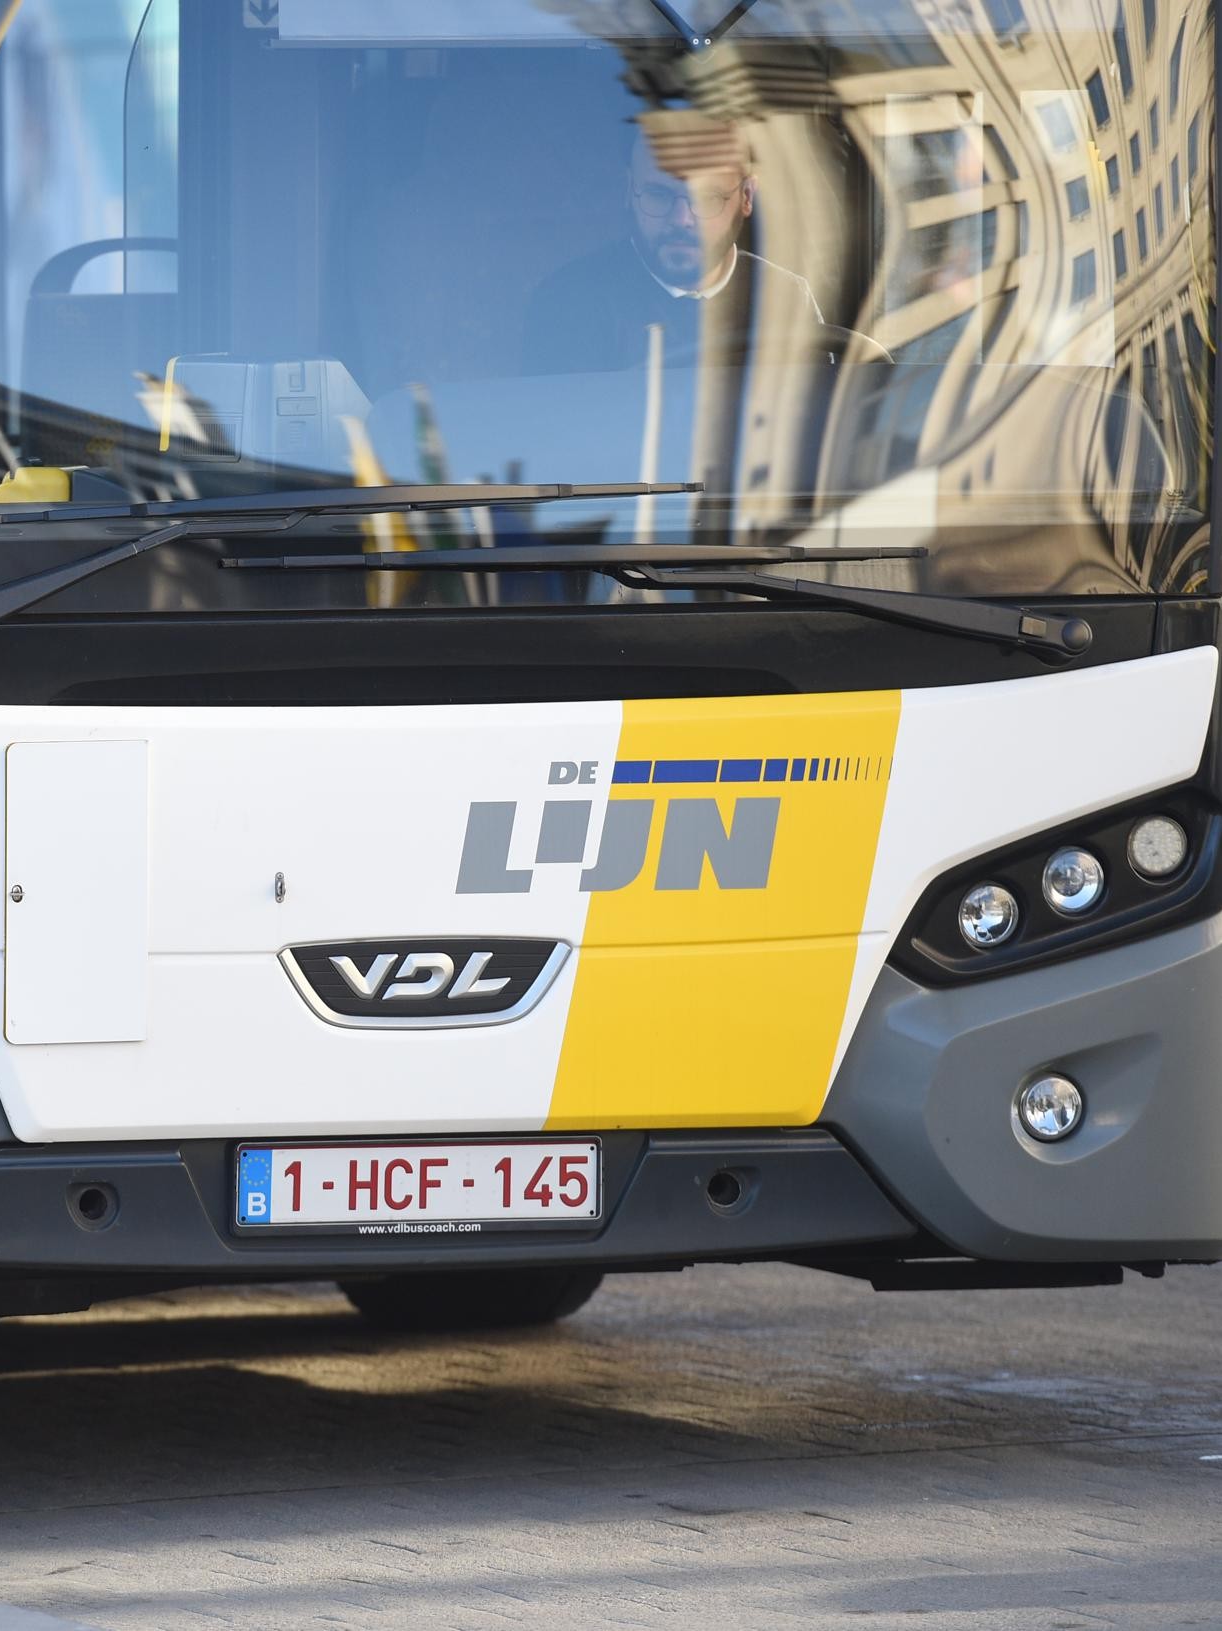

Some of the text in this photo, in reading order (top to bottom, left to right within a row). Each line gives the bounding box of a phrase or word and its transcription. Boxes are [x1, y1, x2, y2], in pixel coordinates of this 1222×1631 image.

[547, 761, 599, 785] DE
[455, 797, 782, 894] LIJN
[329, 952, 511, 1000] VDL
[247, 1192, 267, 1217] B
[358, 1222, 482, 1234] www.vdlbuscoach.com
